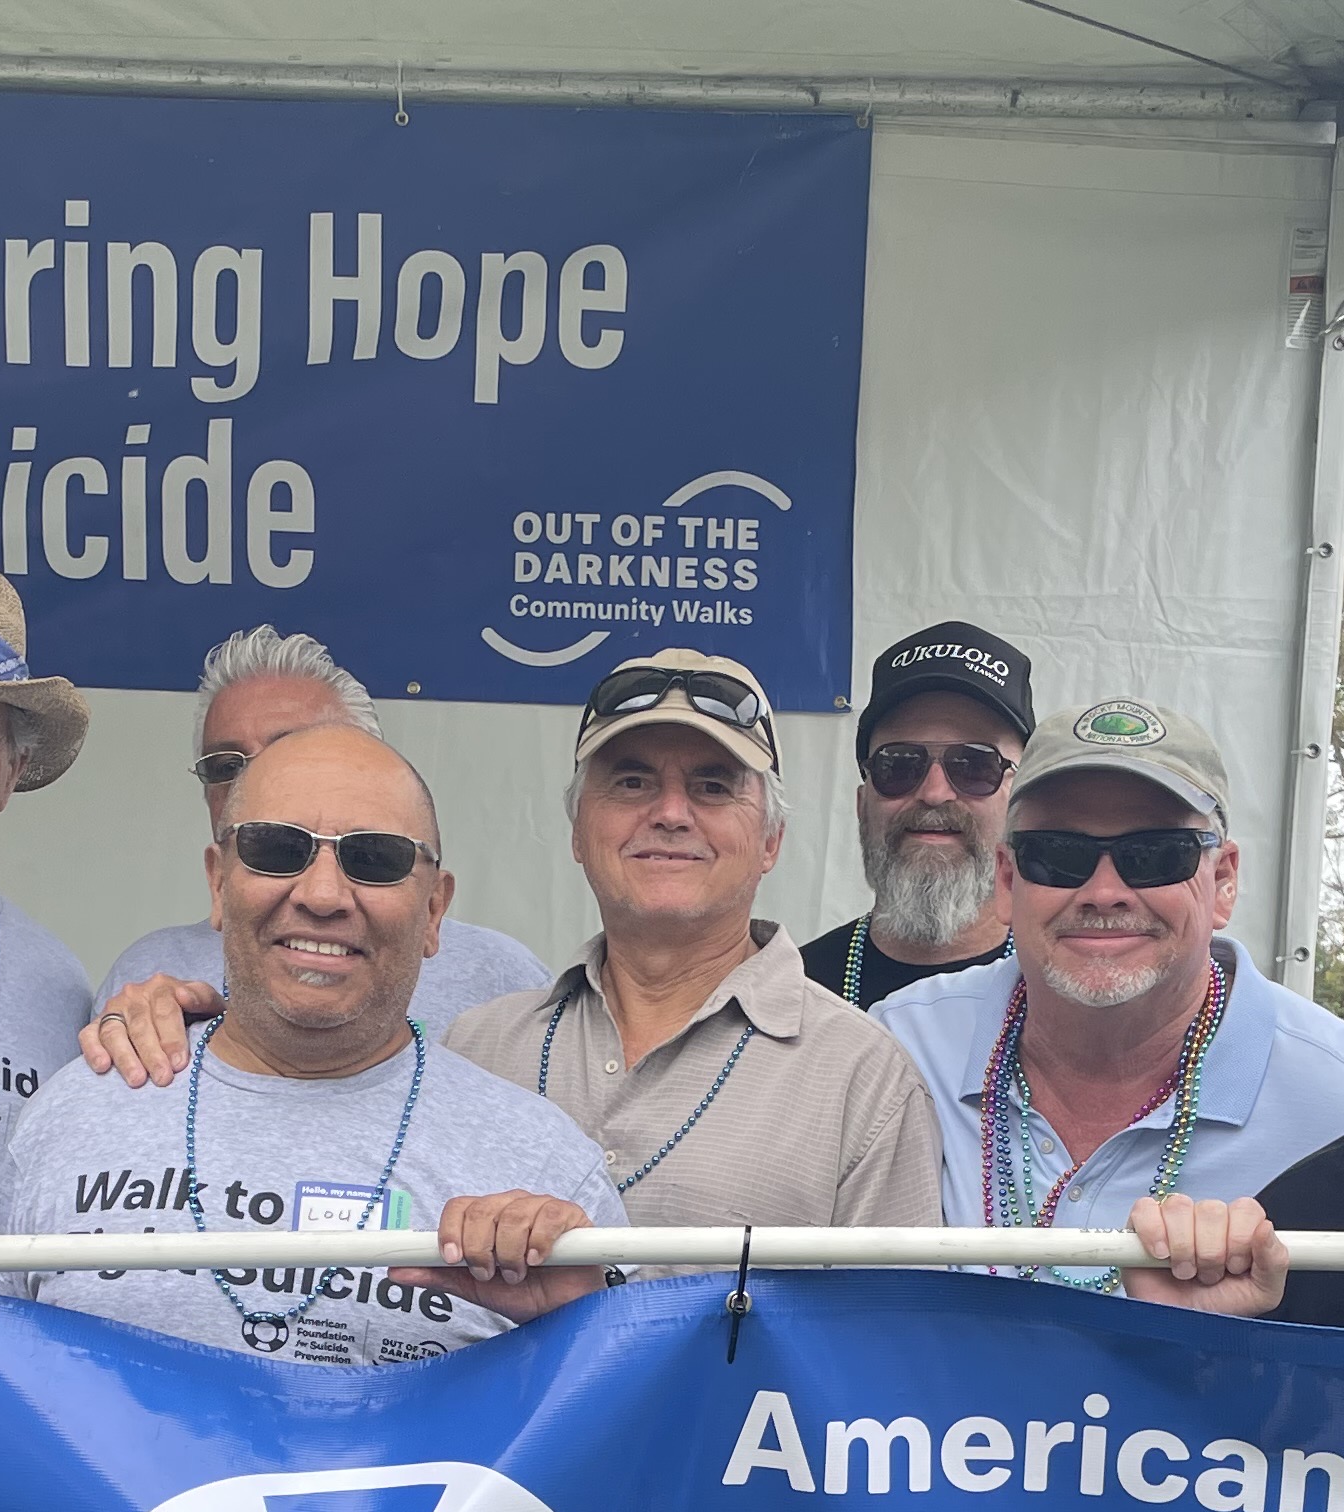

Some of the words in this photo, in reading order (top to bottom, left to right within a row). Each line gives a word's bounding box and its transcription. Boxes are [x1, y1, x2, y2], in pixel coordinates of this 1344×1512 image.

[307, 213, 627, 403] Hope
[514, 512, 600, 544] OUT
[612, 515, 665, 546] OF
[678, 517, 759, 550] THE
[515, 552, 757, 590] DARKNESS
[510, 595, 665, 626] Community
[672, 600, 752, 624] Walks
[891, 644, 1009, 676] UKULOLO
[76, 1167, 208, 1213] Walk
[225, 1180, 284, 1225] to
[297, 1315, 348, 1330] American
[297, 1328, 355, 1343] Foundation
[382, 1338, 404, 1349] OUT
[294, 1351, 351, 1364] Prevention
[309, 1342, 349, 1354] Suicide
[381, 1347, 425, 1360] DARKN
